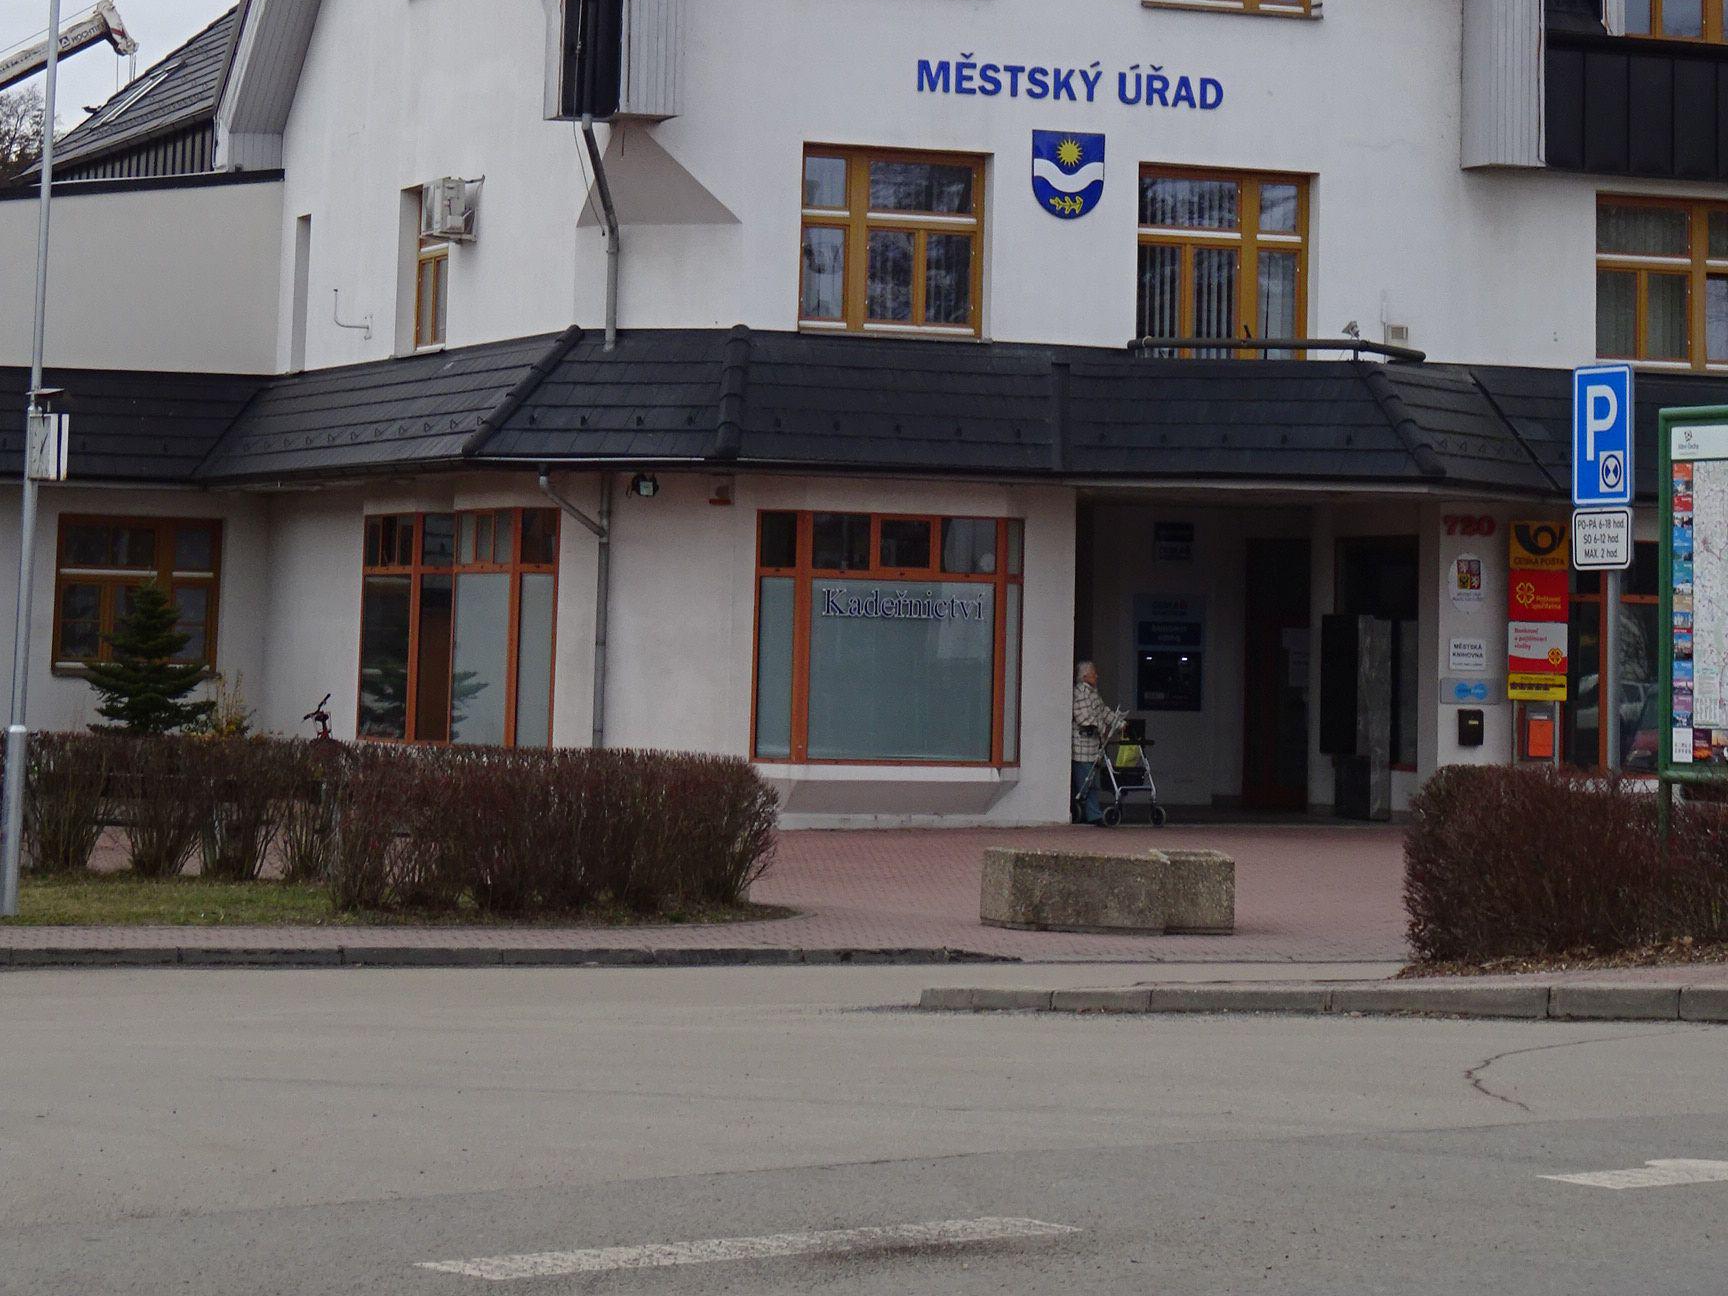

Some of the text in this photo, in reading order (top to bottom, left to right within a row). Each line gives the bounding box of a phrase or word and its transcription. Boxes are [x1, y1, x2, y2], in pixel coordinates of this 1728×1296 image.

[917, 52, 1224, 110] MĚSTSKÝ ÚŘAD
[1586, 384, 1618, 462] P
[1599, 518, 1611, 530] 6-18
[1583, 533, 1592, 545] SO
[1593, 533, 1605, 544] 6-12
[1600, 548, 1605, 559] 2
[822, 587, 985, 621] Kadeřnictví
